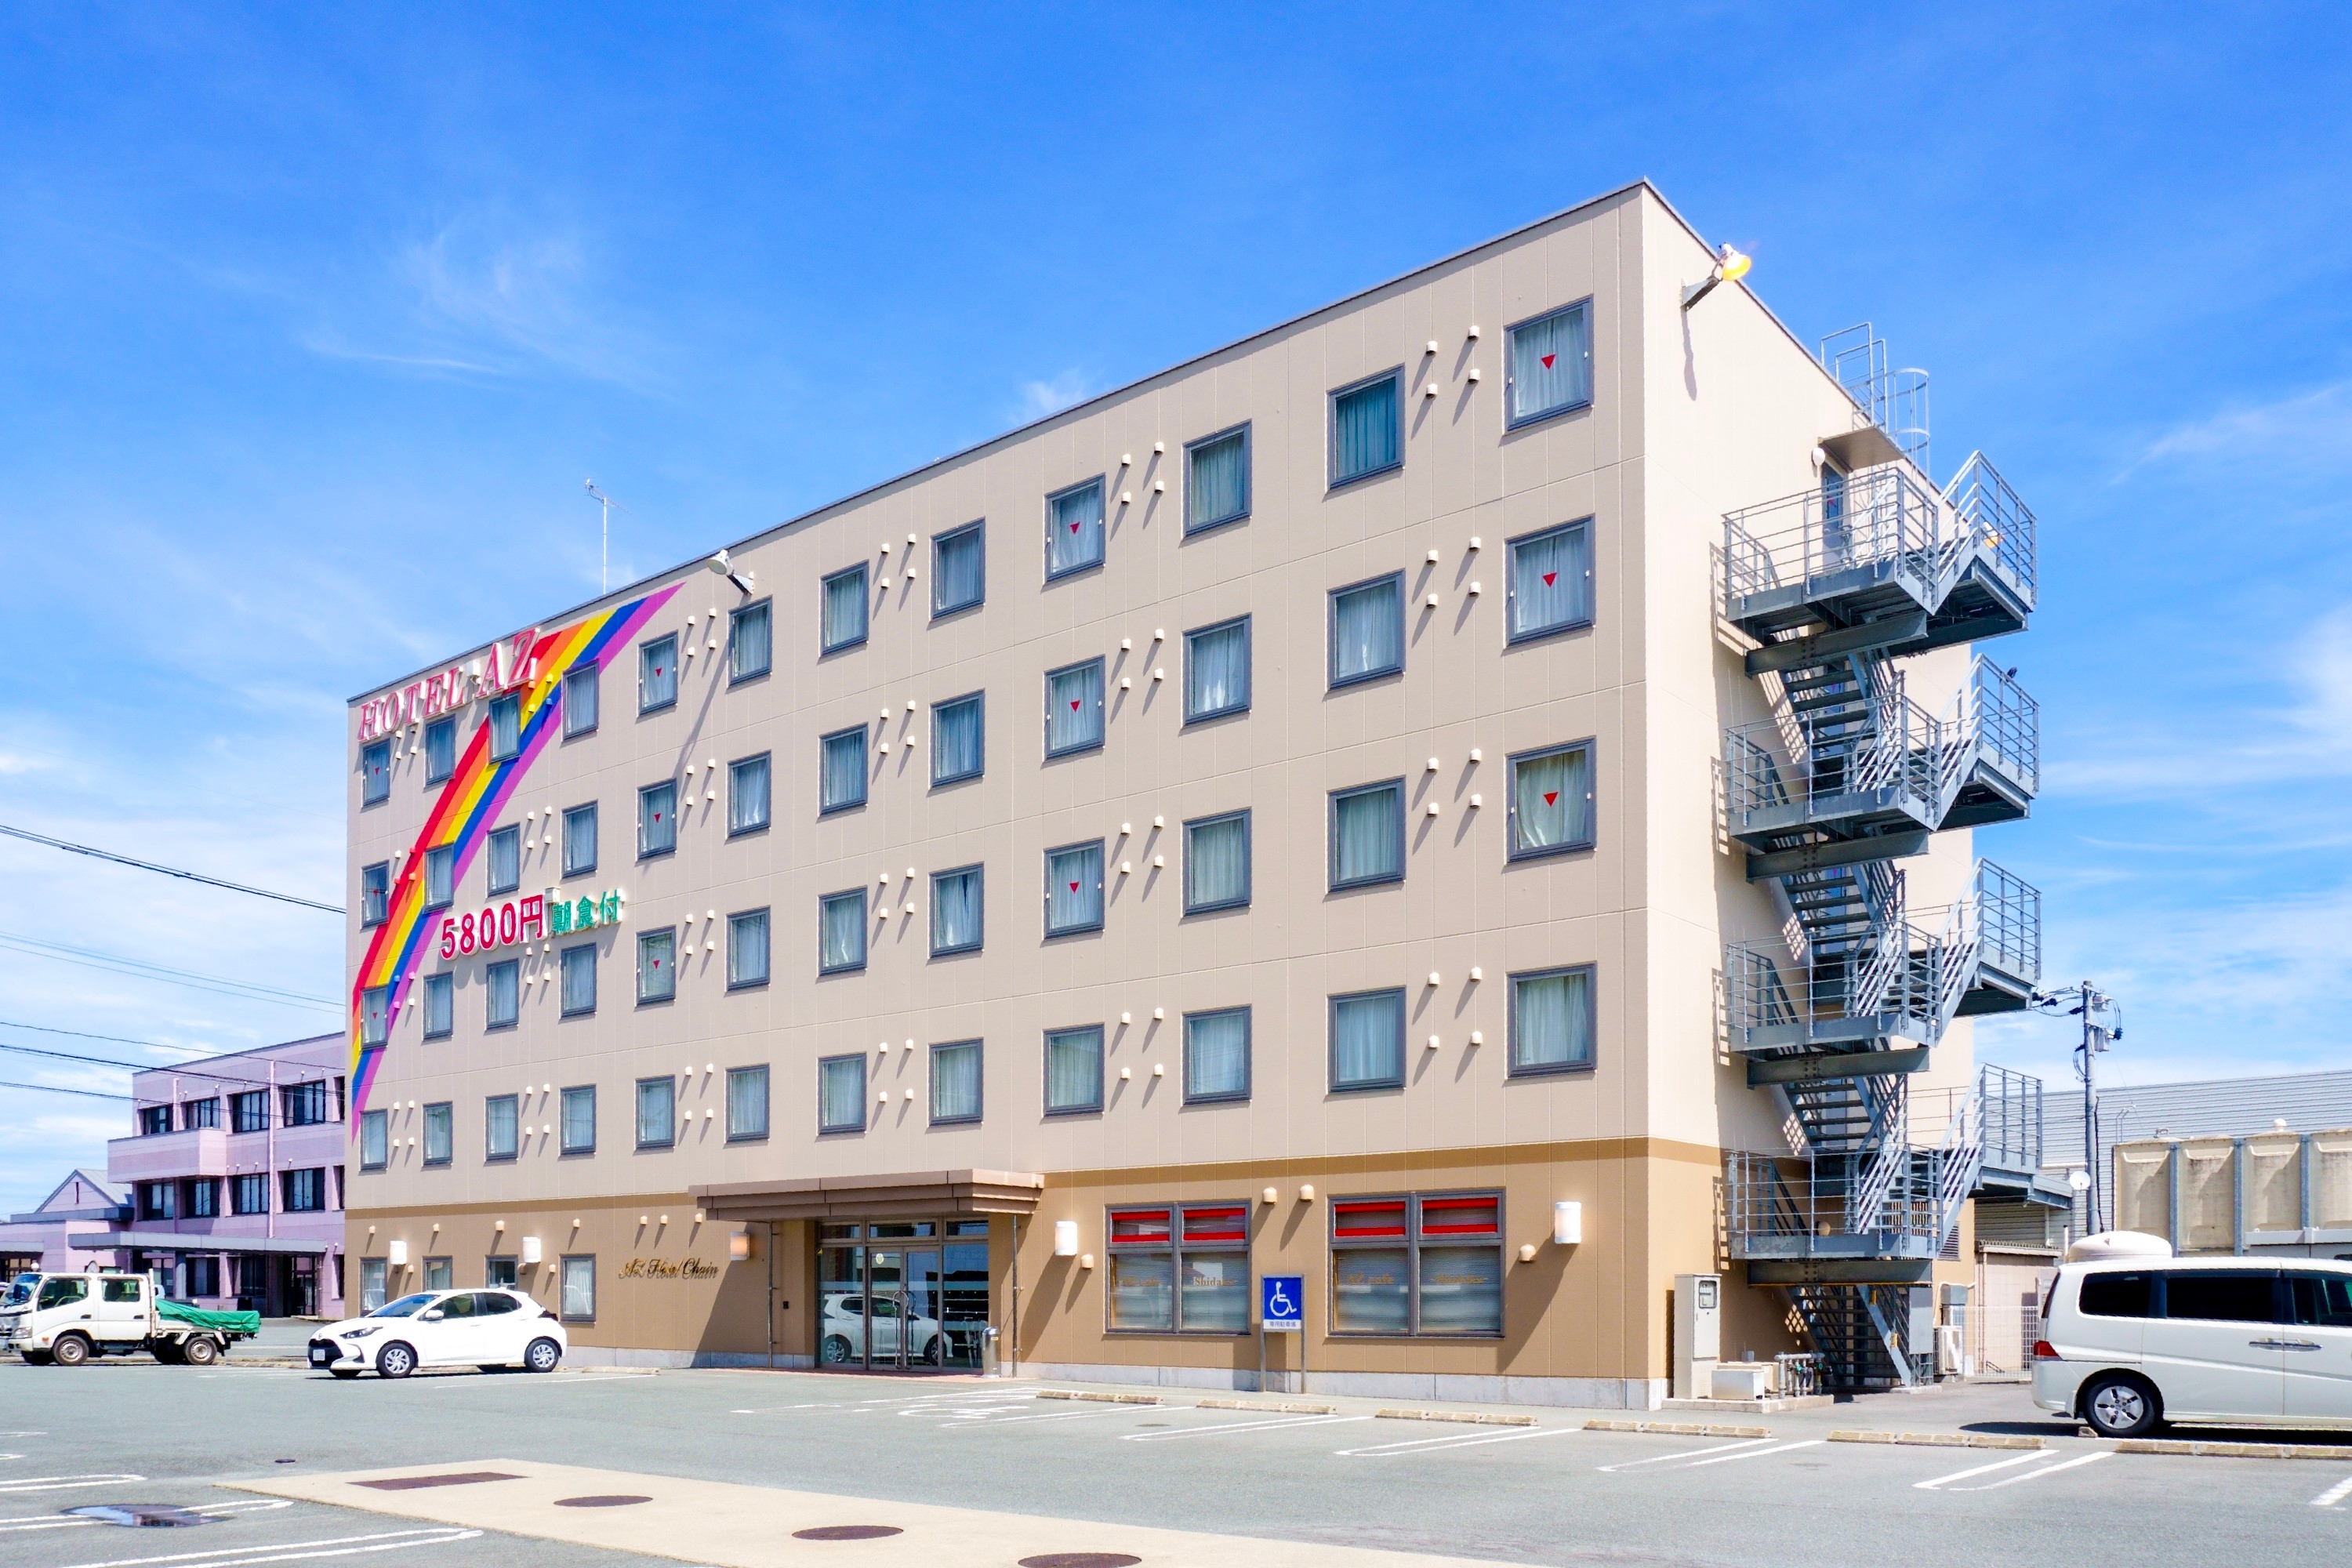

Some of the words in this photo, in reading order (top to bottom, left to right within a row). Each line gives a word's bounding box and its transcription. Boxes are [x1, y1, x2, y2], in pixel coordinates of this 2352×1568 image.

[358, 666, 466, 742] HOTEL
[475, 627, 541, 700] AZ
[441, 894, 547, 960] 5800円
[551, 888, 622, 935] 朝食付
[683, 1258, 719, 1276] Chain
